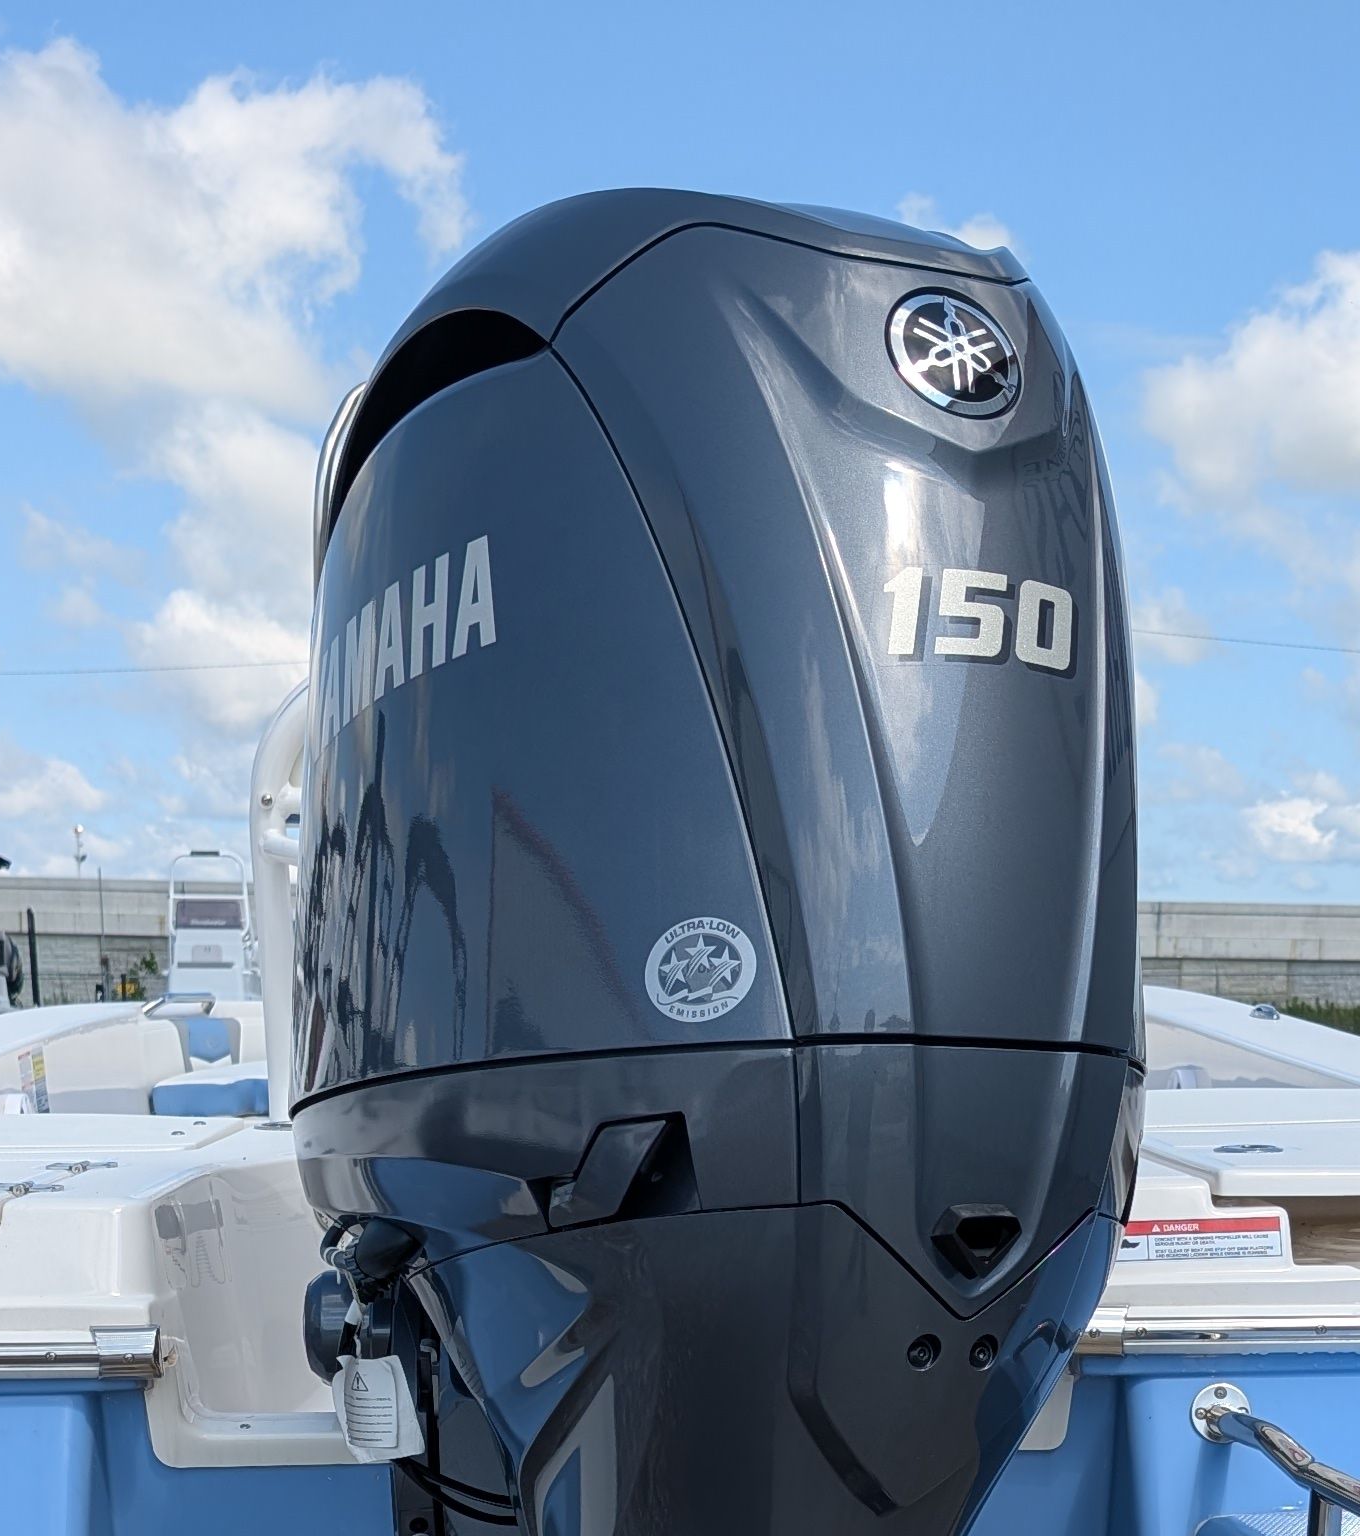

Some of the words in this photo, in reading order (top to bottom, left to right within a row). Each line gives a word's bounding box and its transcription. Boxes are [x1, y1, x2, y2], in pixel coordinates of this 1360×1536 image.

[883, 566, 1077, 676] 150
[668, 1000, 729, 1019] EMISSION
[1162, 1223, 1200, 1232] DANGER
